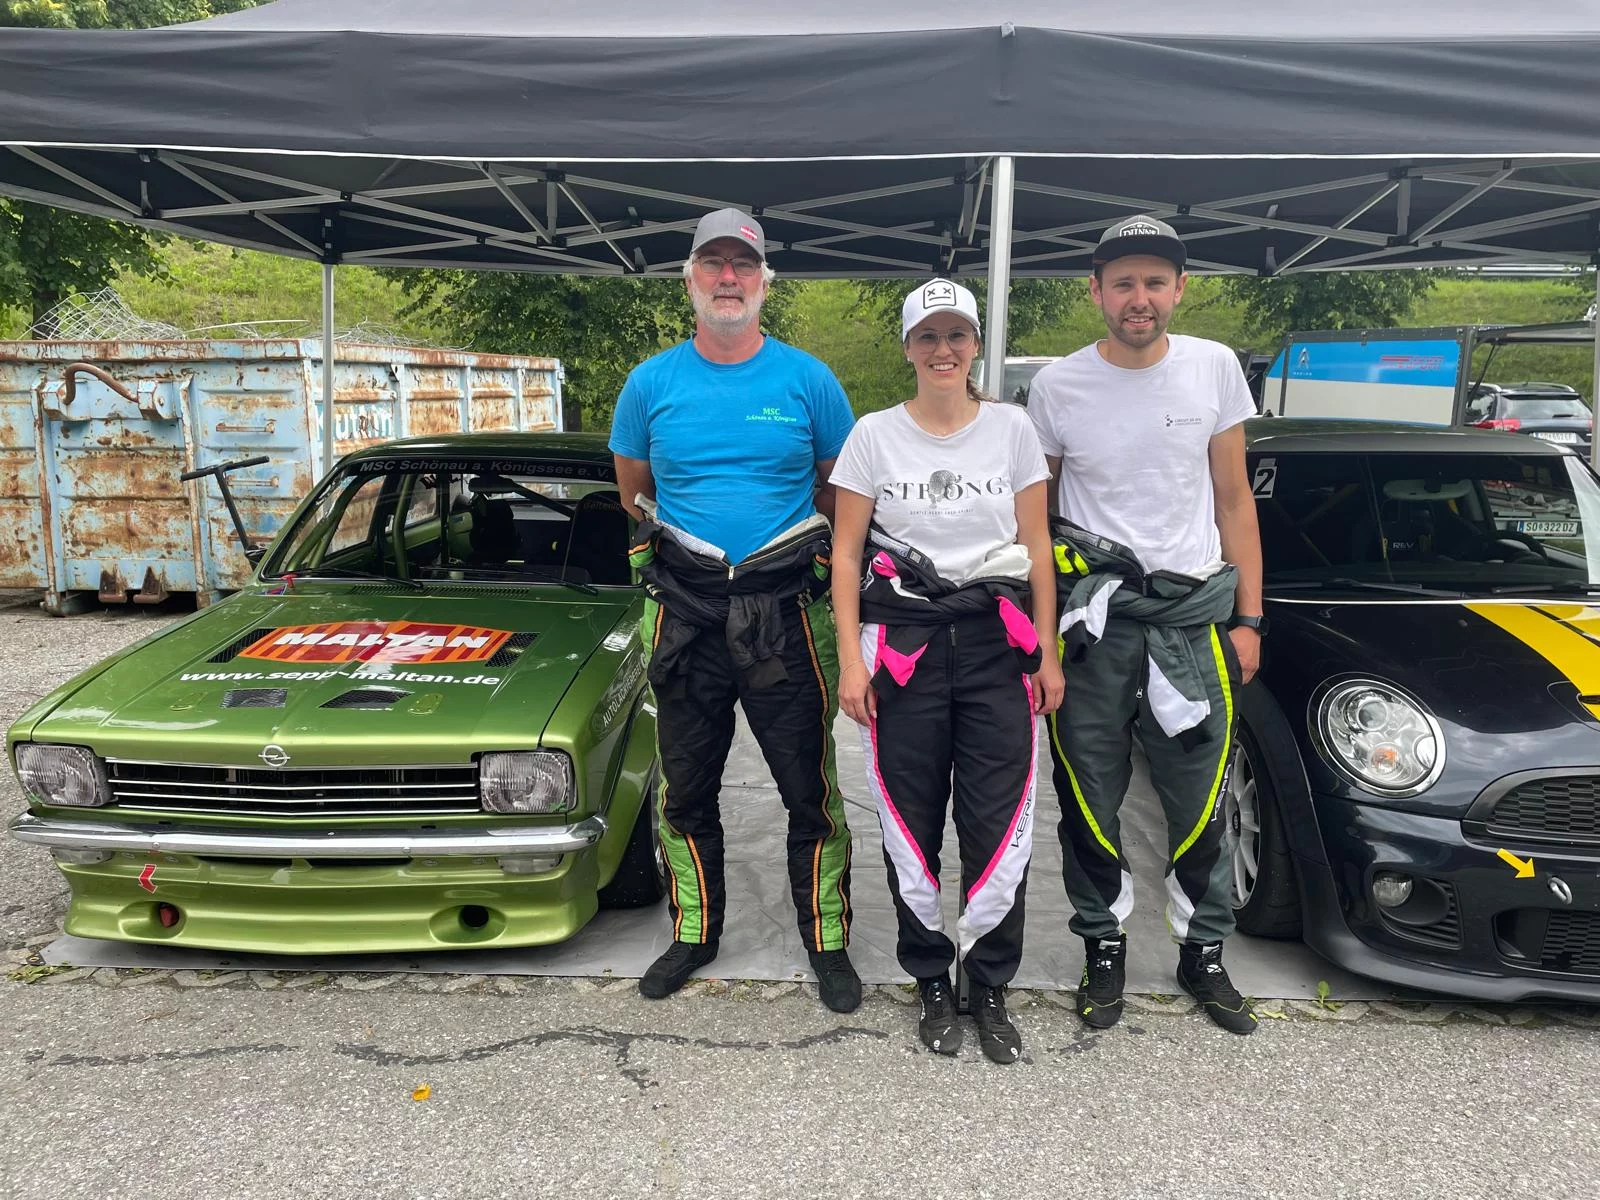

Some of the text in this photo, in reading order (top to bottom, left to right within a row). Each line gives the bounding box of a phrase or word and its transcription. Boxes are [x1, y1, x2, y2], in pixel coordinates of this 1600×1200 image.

[762, 408, 781, 416] MSC
[359, 459, 610, 478] MSC Schönau a. Königssee e. V.
[882, 476, 1003, 501] STRONG
[1253, 468, 1275, 496] 2
[1543, 522, 1561, 532] 322
[272, 632, 492, 648] MALTAN
[179, 670, 501, 686] www.sepp-maltan.de
